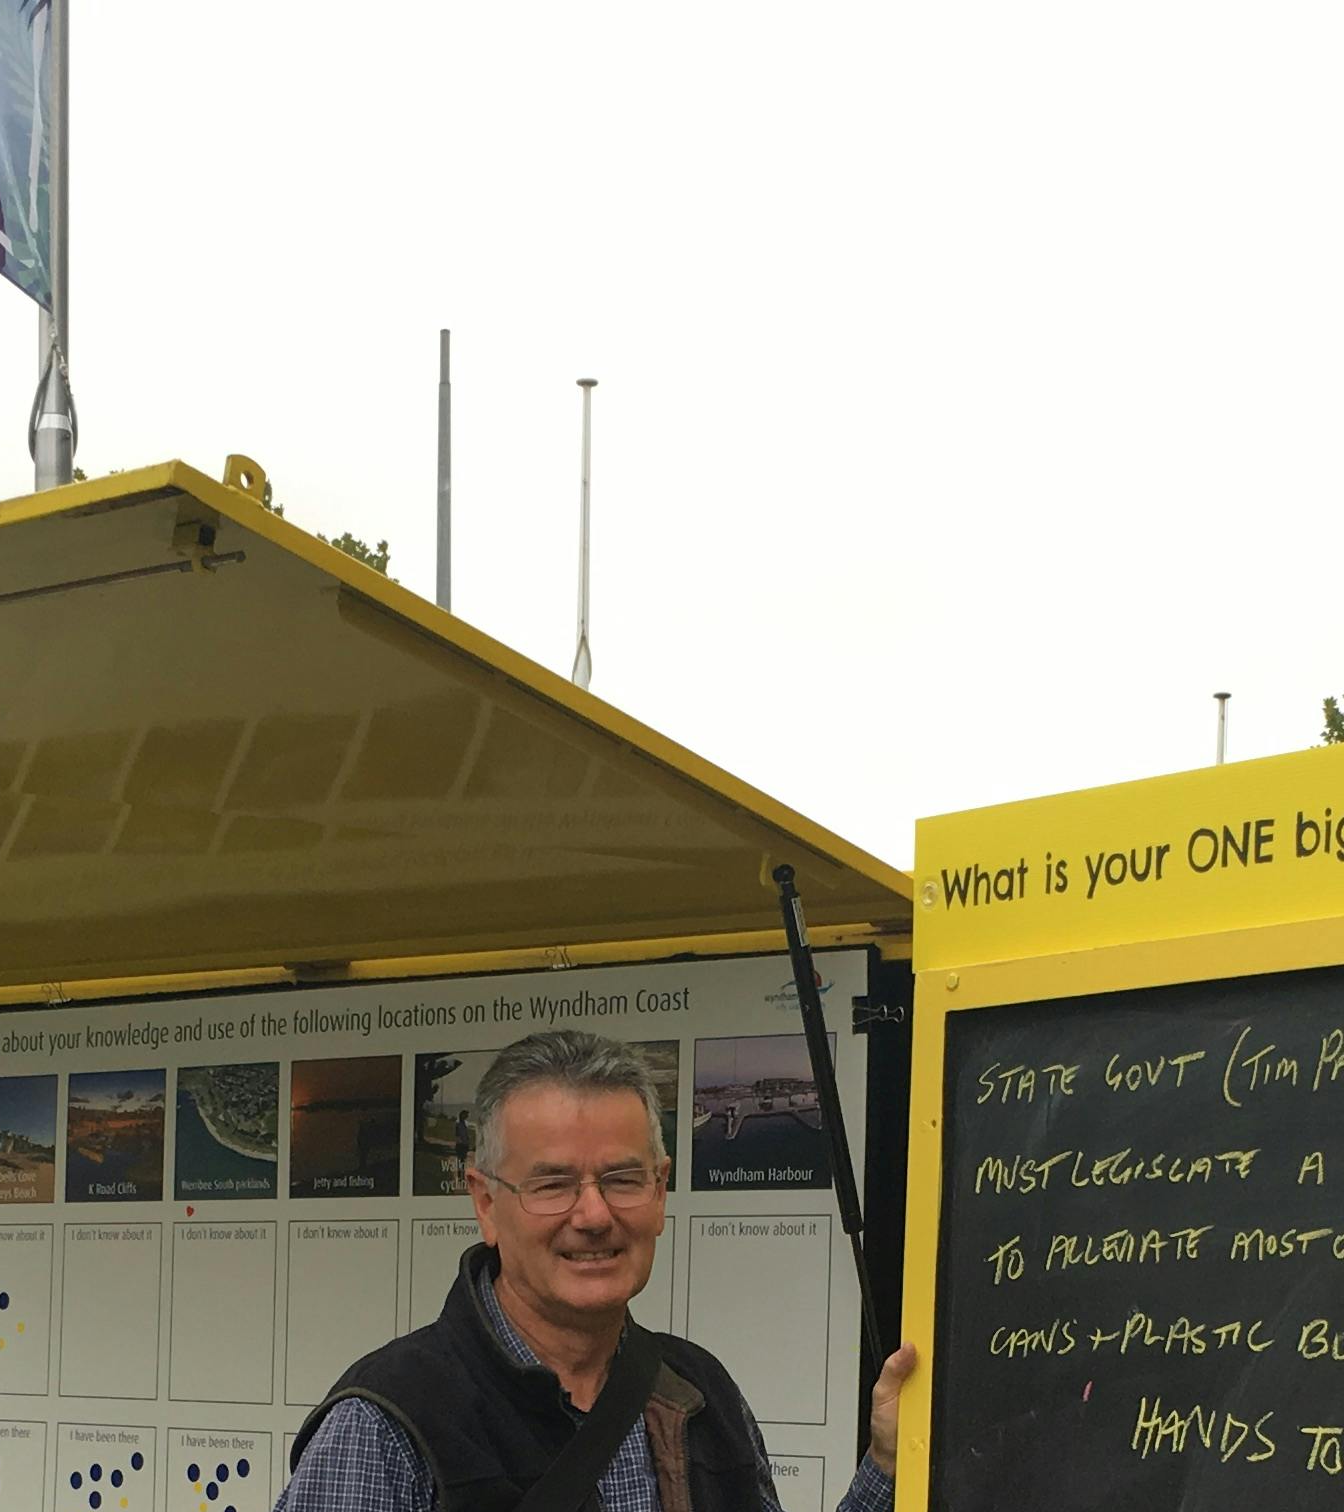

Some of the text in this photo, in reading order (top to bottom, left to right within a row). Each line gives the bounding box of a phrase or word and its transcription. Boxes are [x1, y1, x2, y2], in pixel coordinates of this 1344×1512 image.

[941, 857, 1029, 910] What
[1045, 852, 1068, 893] is
[1085, 839, 1170, 899] your
[1187, 819, 1274, 874] ONE
[1, 1030, 44, 1053] about
[48, 1031, 82, 1056] your
[86, 1022, 168, 1050] knowledge
[174, 1018, 203, 1042] and
[208, 1021, 234, 1040] use
[240, 1014, 256, 1037] of
[261, 1013, 287, 1036] the
[293, 1007, 371, 1037] following
[378, 1003, 456, 1029] locations
[463, 1002, 485, 1024] on
[492, 996, 522, 1021] the
[529, 990, 628, 1024] Wyndham
[636, 987, 690, 1014] Coast
[977, 1063, 1082, 1104] STATE
[1105, 1050, 1206, 1092] GOVT
[213, 1179, 234, 1190] South
[313, 1174, 375, 1190] Jetty and fishing
[709, 1166, 814, 1186] Wyndham Harbour
[975, 1150, 1072, 1195] MUST
[1298, 1150, 1324, 1186] A
[96, 1183, 115, 1194] Road
[303, 1226, 325, 1240] don't
[327, 1226, 352, 1239] know
[354, 1225, 379, 1238] about
[381, 1226, 388, 1238] it
[708, 1222, 736, 1237] don't
[740, 1221, 769, 1236] know
[773, 1222, 805, 1236] about
[808, 1222, 817, 1235] it
[984, 1235, 1024, 1286] TO
[1231, 1227, 1333, 1263] MOST
[990, 1317, 1077, 1359] CANS
[186, 1435, 206, 1447] have
[209, 1437, 230, 1448] been
[232, 1437, 254, 1450] there
[1132, 1396, 1275, 1463] HANDS
[1299, 1425, 1343, 1475] TO
